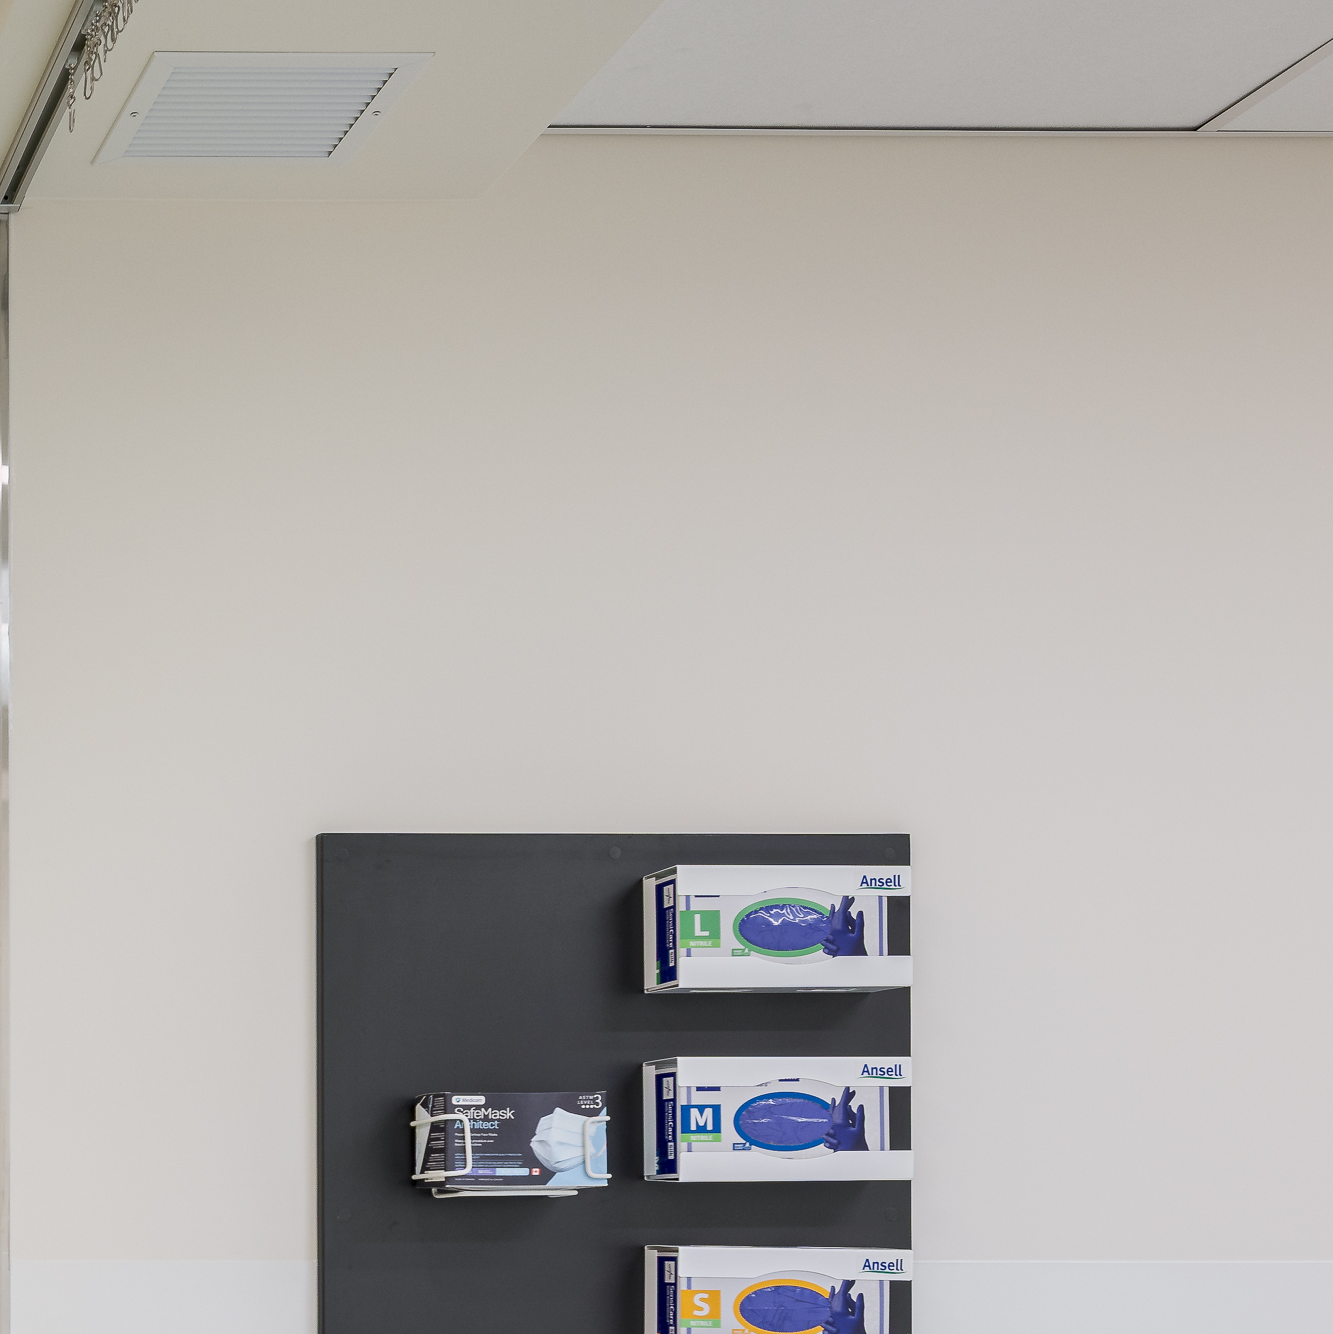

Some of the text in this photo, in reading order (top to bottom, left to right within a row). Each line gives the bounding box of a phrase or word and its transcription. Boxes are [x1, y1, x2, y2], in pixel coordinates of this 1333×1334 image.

[860, 874, 902, 887] Ansell
[694, 913, 710, 936] L
[861, 1063, 903, 1076] Ansell
[593, 1094, 603, 1109] 3
[690, 1107, 713, 1131] M
[862, 1258, 904, 1271] Ansell
[693, 1292, 710, 1316] S
